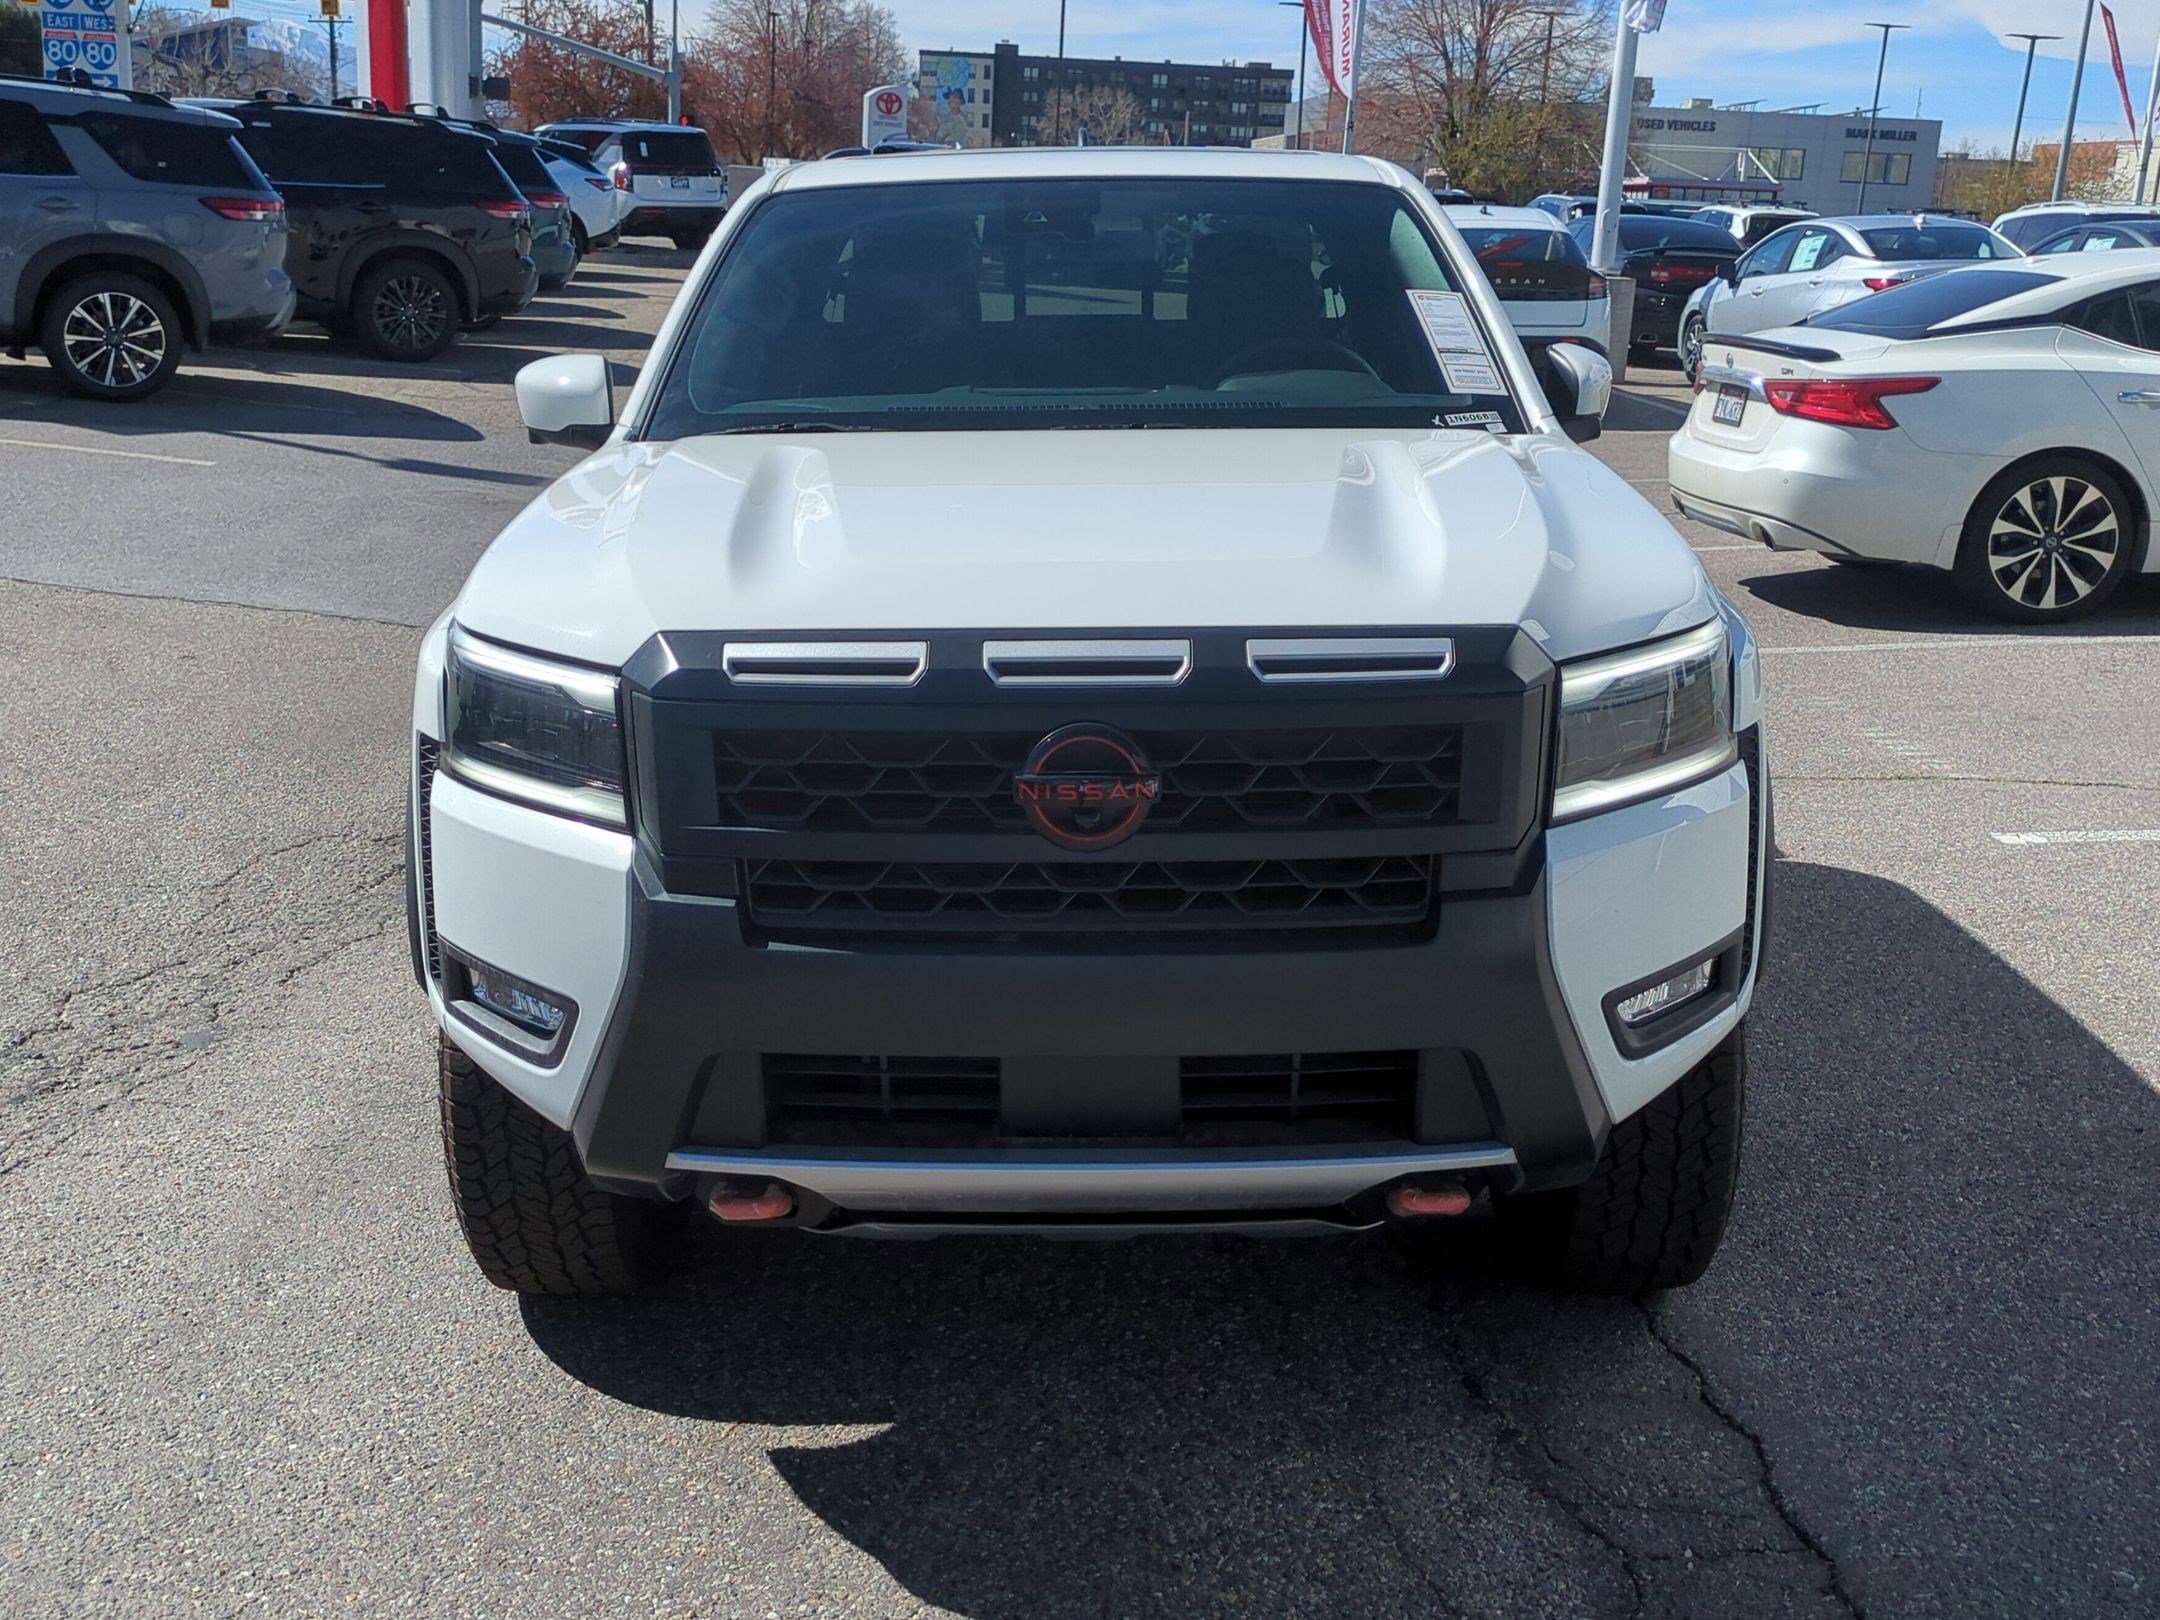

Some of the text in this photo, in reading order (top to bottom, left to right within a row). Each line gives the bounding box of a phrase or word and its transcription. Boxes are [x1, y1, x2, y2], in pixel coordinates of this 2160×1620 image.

[47, 14, 74, 27] EAST
[48, 40, 77, 62] 80
[86, 43, 115, 64] 80
[1667, 120, 1717, 132] VEHICLES
[1018, 782, 1157, 801] NISSAN
